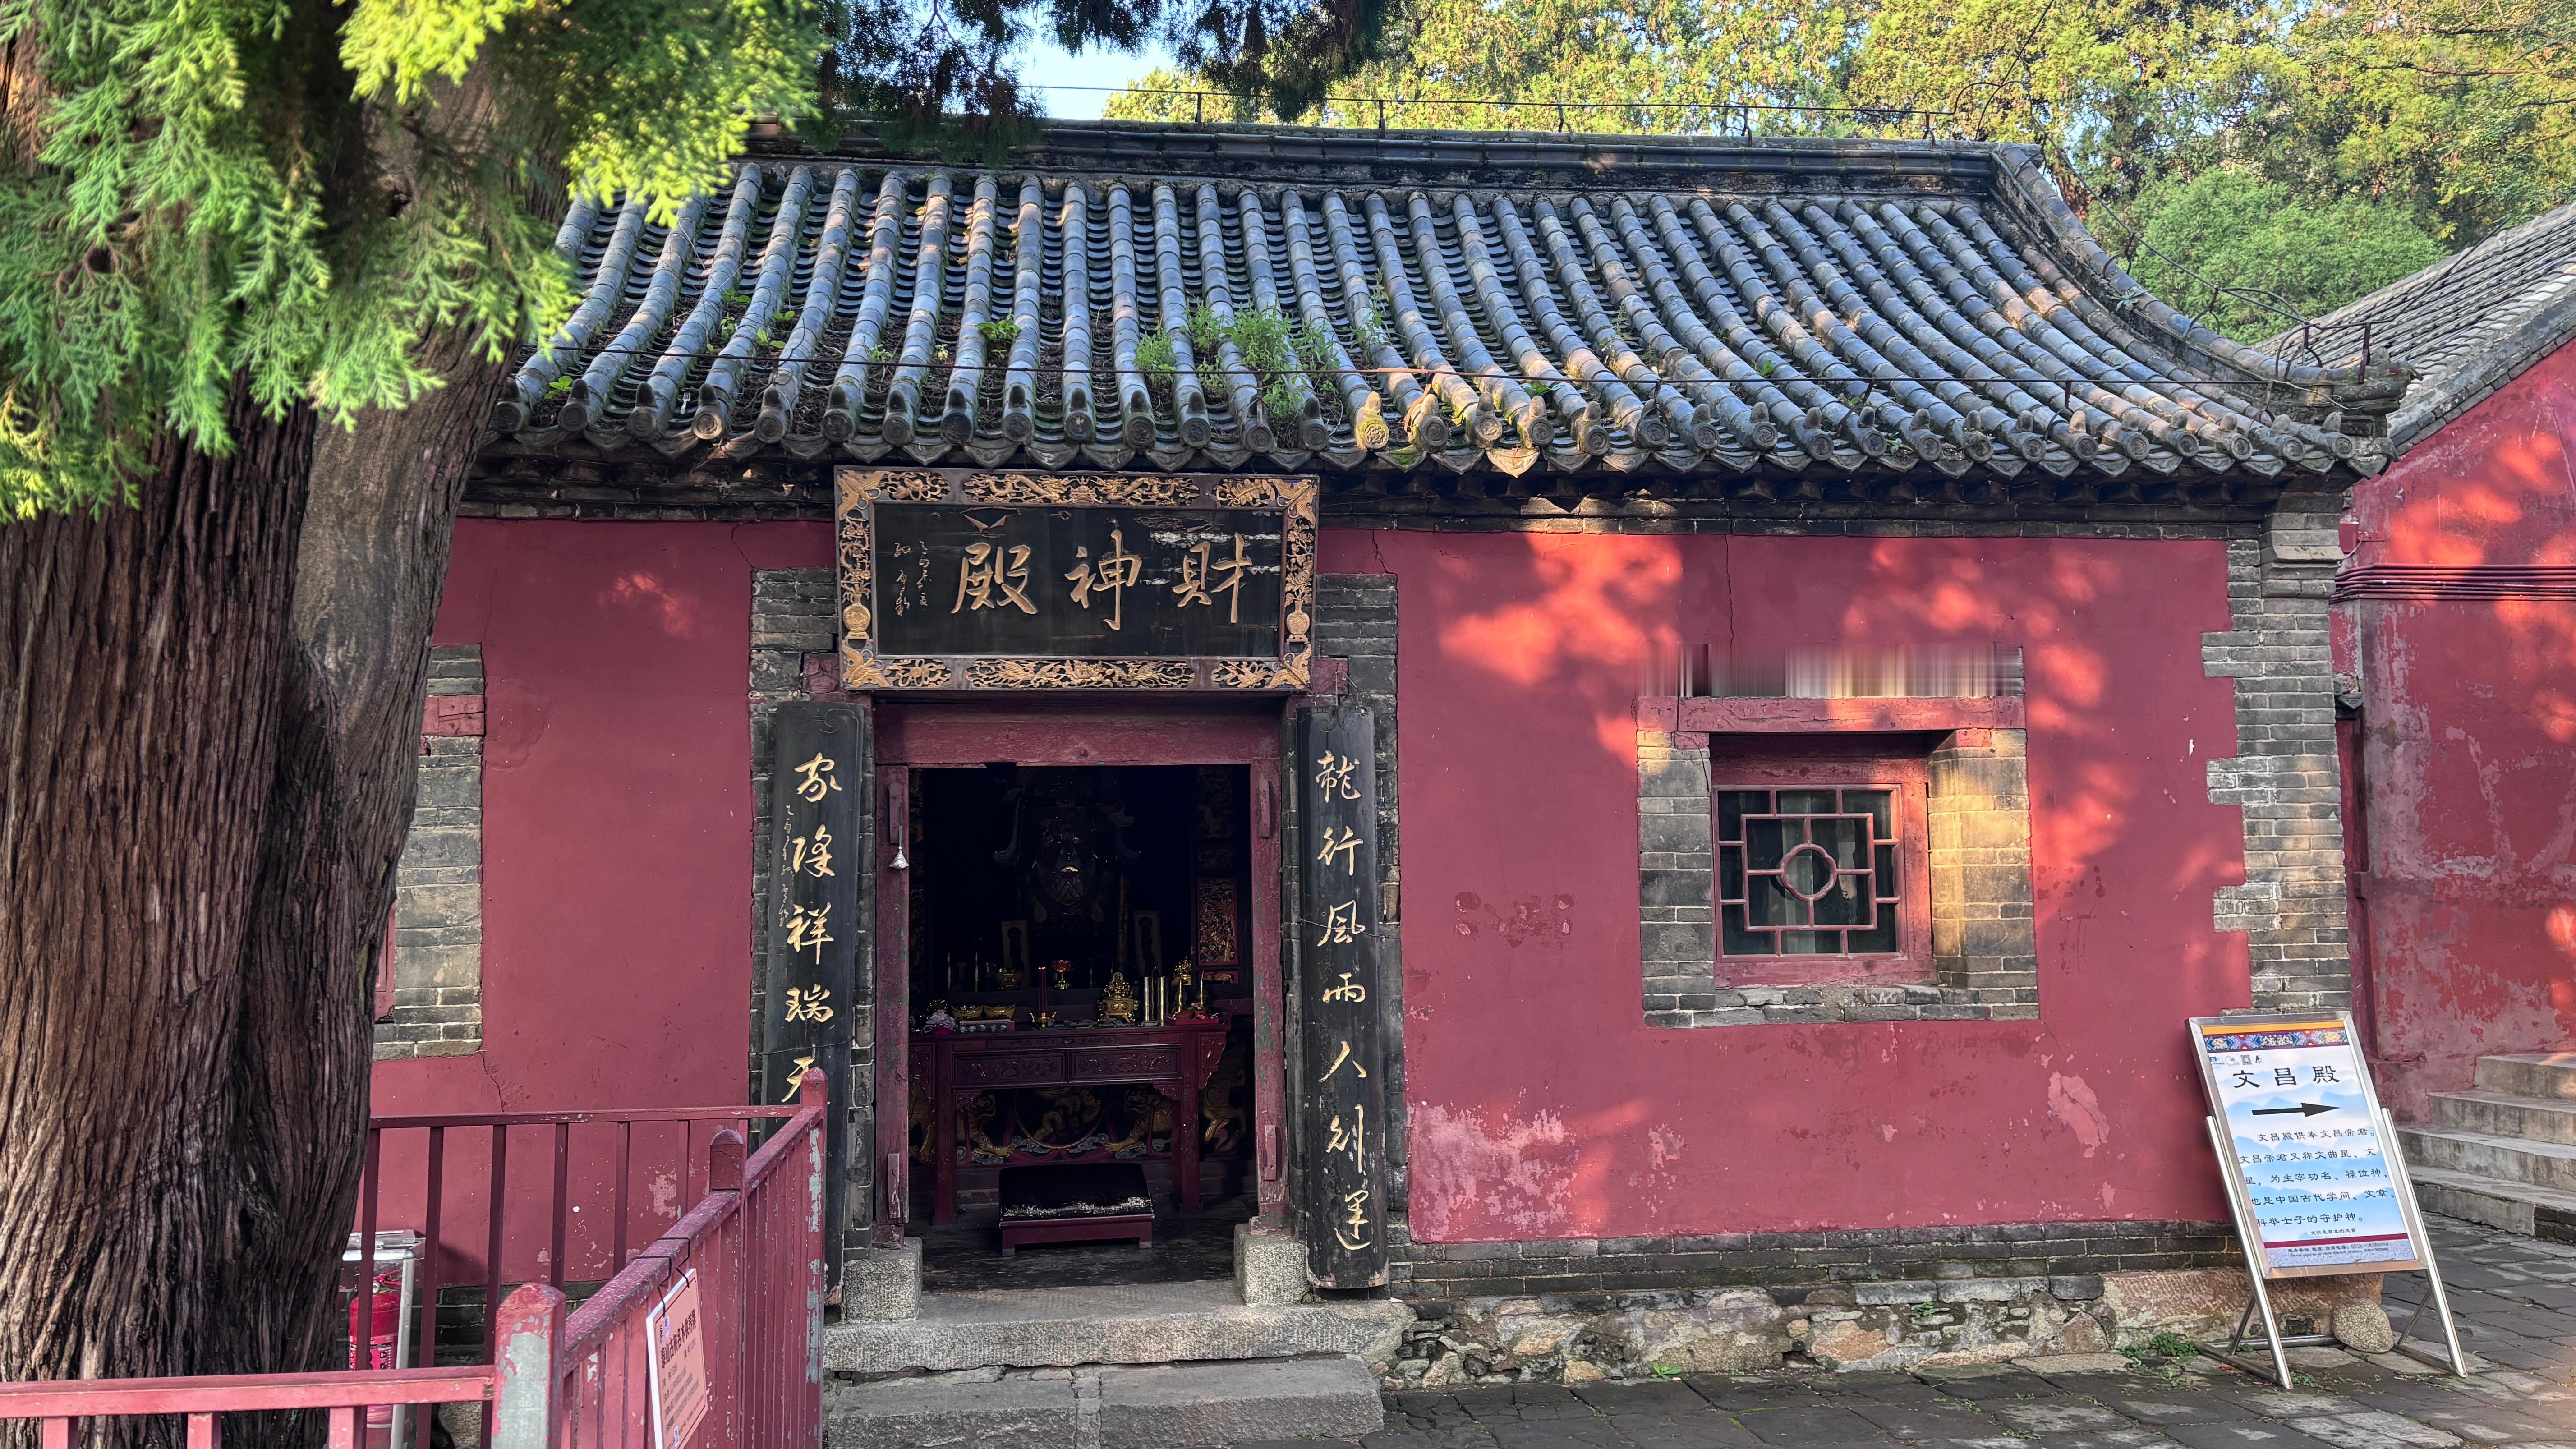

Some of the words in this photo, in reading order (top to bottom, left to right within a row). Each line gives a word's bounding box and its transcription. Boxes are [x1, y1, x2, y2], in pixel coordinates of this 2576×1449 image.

[2233, 1065, 2340, 1088] 文昌殿
[2257, 1128, 2375, 1142] 文昌殿供奉文昌帝君。
[2257, 1212, 2363, 1227] 科举士子的守护神。
